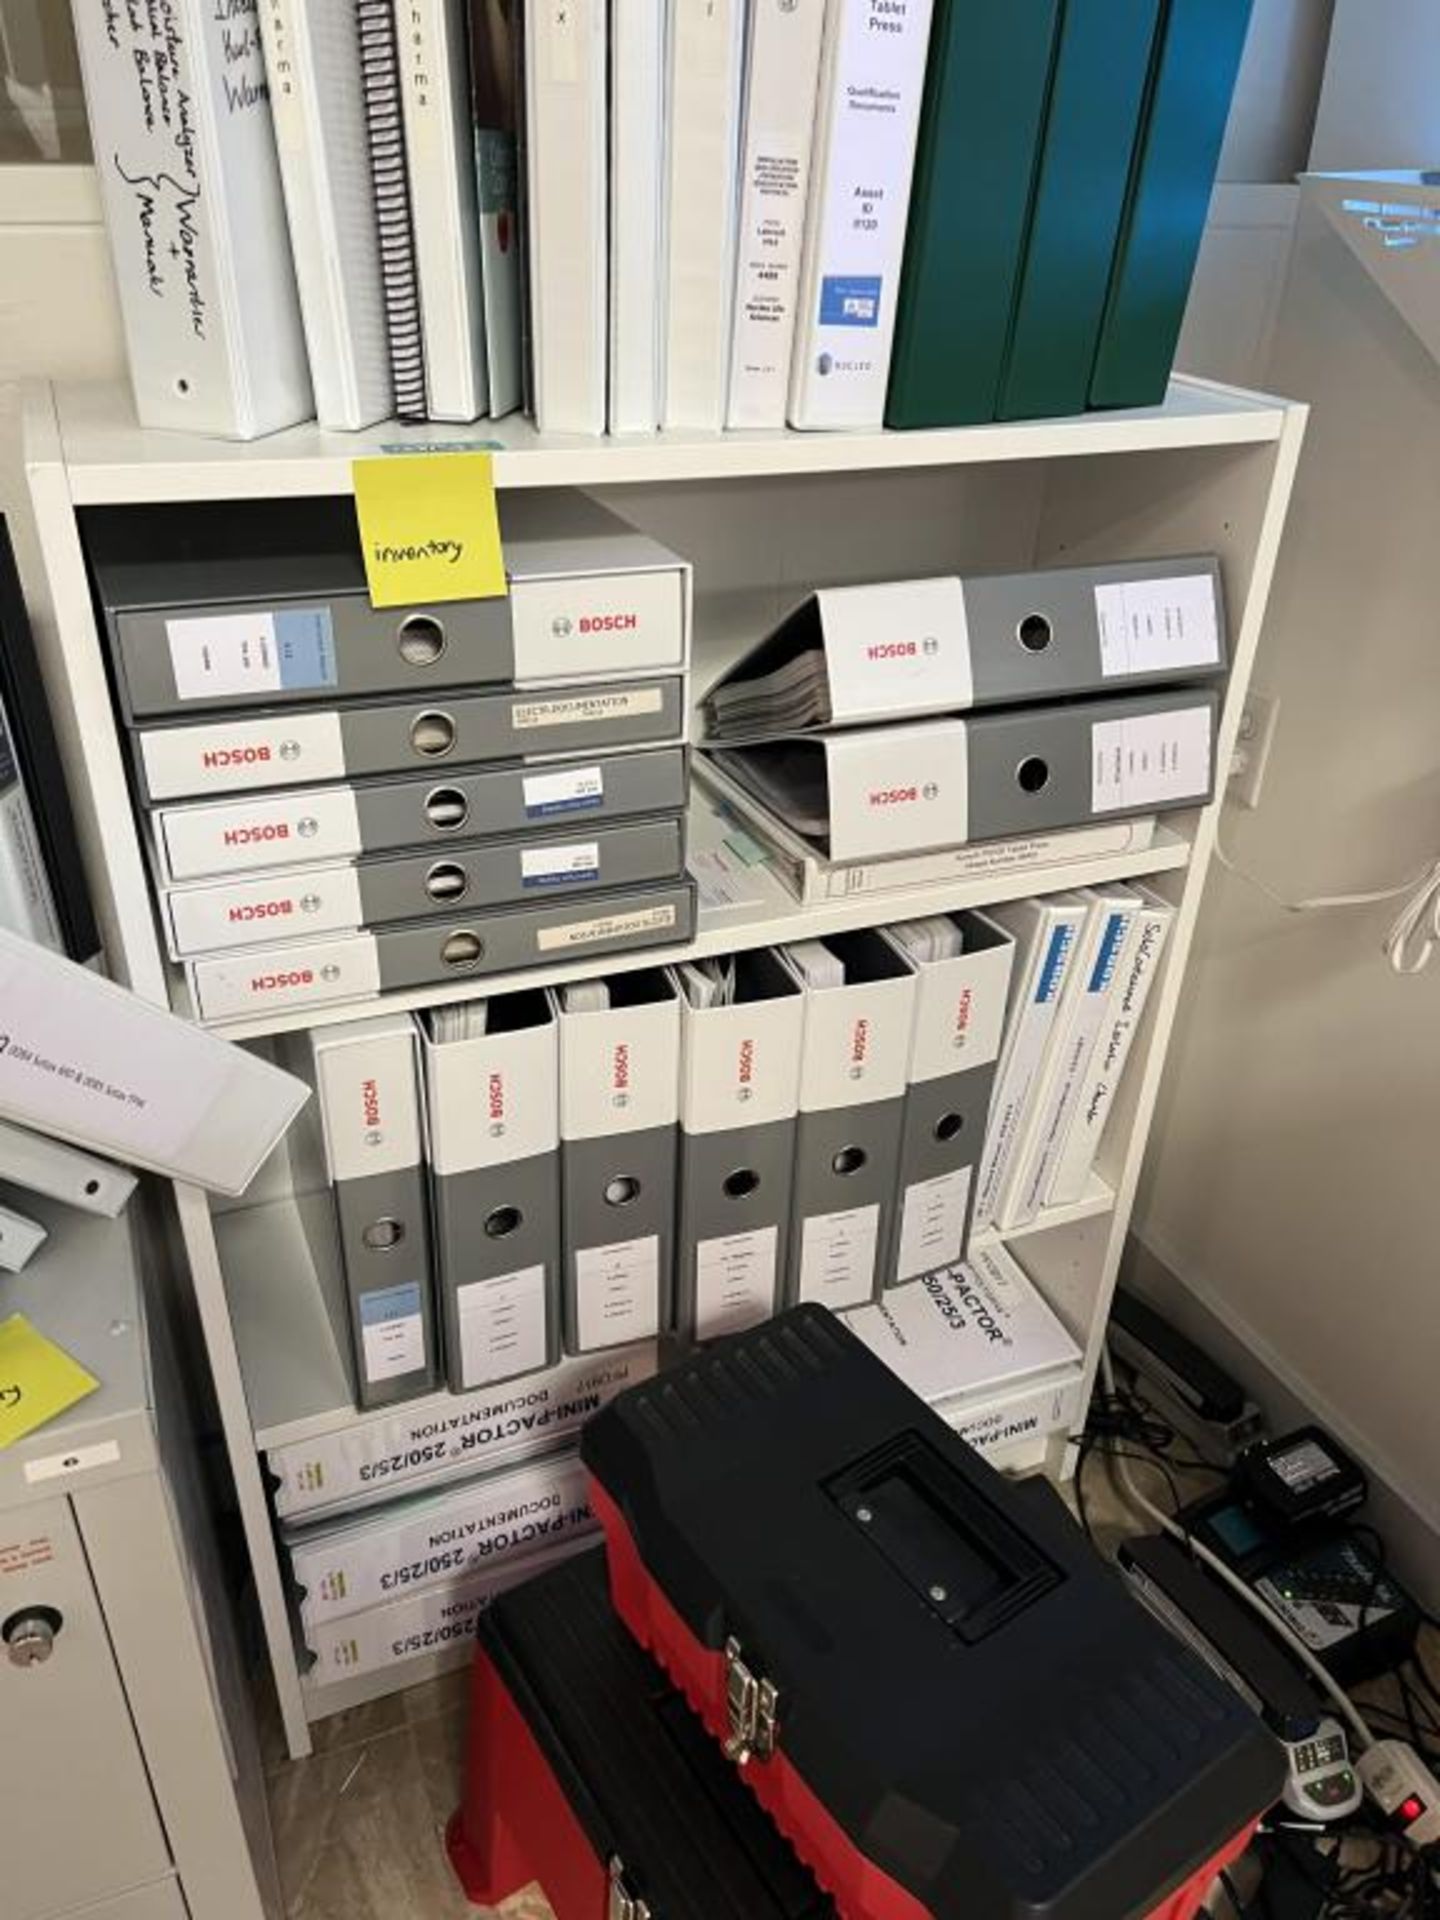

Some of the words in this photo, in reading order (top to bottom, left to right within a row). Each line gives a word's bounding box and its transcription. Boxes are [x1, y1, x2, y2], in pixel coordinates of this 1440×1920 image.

[868, 16, 903, 34] Press
[871, 0, 906, 16] Tablet
[133, 48, 155, 134] Balance
[159, 0, 181, 79] oisture
[174, 89, 197, 178] Analyzer
[374, 539, 463, 564] inventory
[578, 614, 638, 634] BOSCH
[867, 642, 918, 660] BOSCH
[203, 746, 271, 768] BOSCH
[869, 786, 919, 806] BOSCH
[224, 823, 290, 846] BOSCH
[229, 899, 293, 922] BOSCH
[251, 969, 314, 991] BOSCH
[956, 989, 972, 1031] BOSCH
[738, 1040, 753, 1083] BOSCH
[852, 1019, 868, 1062] BOSCH
[613, 1044, 629, 1089] BOSCH
[362, 1079, 381, 1126] BOSCH
[489, 1074, 504, 1119] BOSCH
[921, 1275, 966, 1330] 50/25/3
[948, 1267, 1013, 1347] -PACTOR®
[410, 1389, 548, 1441] DOCUMENTATION
[358, 1441, 446, 1481] 250/25/3
[428, 1494, 561, 1549] DOCUMENTATION
[379, 1549, 466, 1592] 250/25/3
